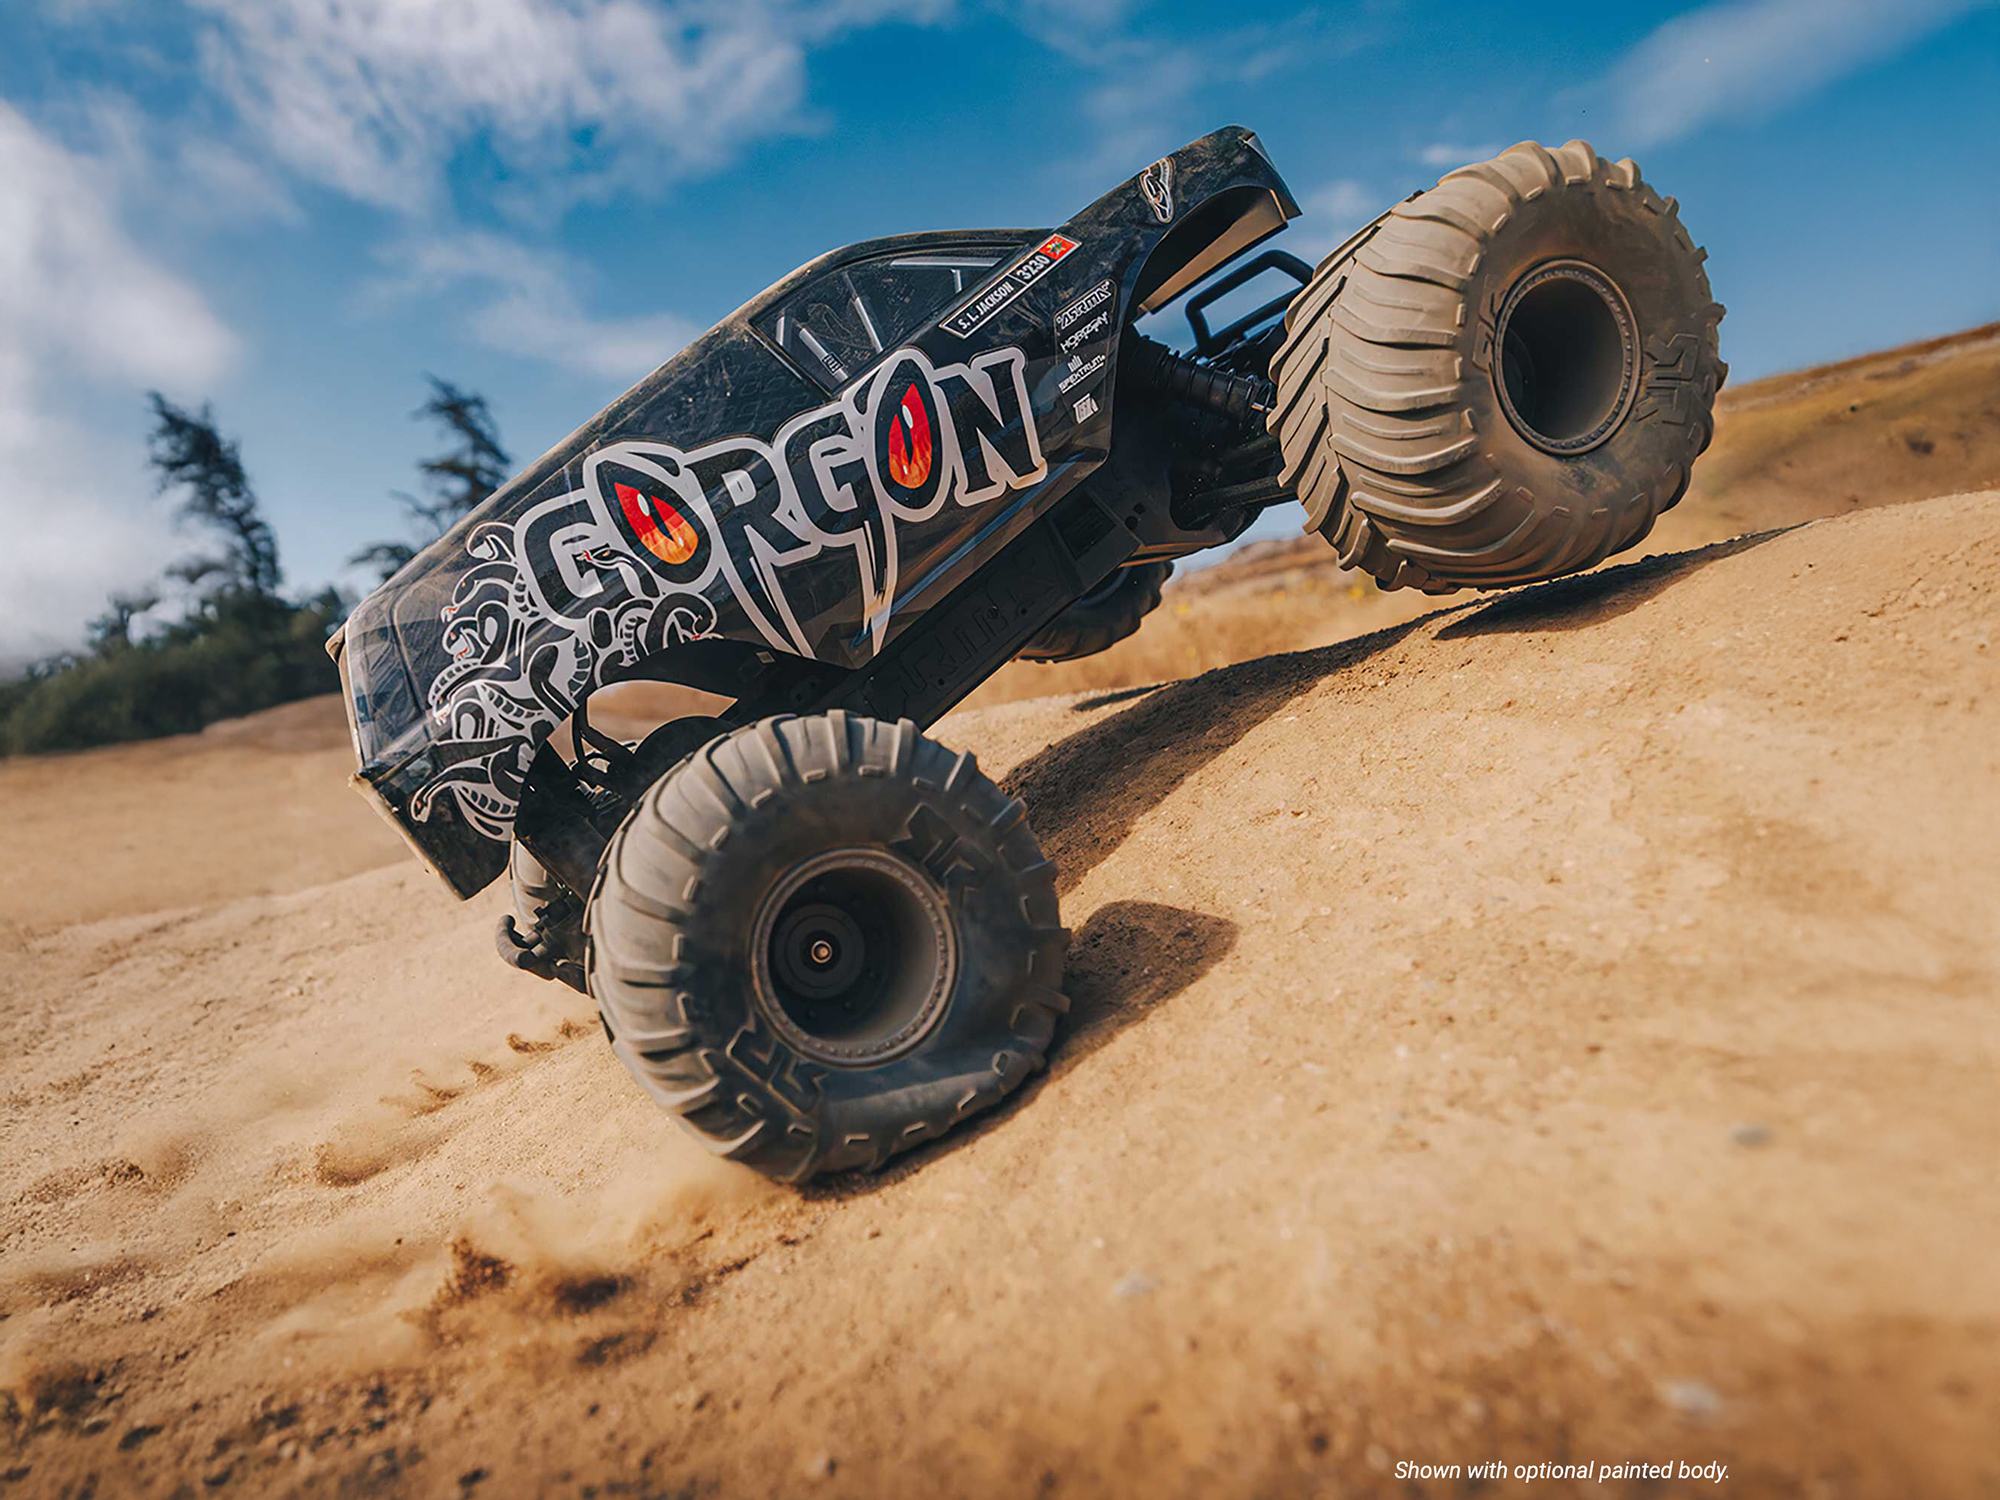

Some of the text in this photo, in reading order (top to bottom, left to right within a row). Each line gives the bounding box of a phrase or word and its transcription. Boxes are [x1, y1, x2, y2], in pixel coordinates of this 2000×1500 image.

[1016, 254, 1051, 281] 3230
[957, 280, 1015, 330] S. L. JACKSON
[1058, 354, 1105, 392] SPEKTRUM
[514, 347, 1047, 659] GORGON
